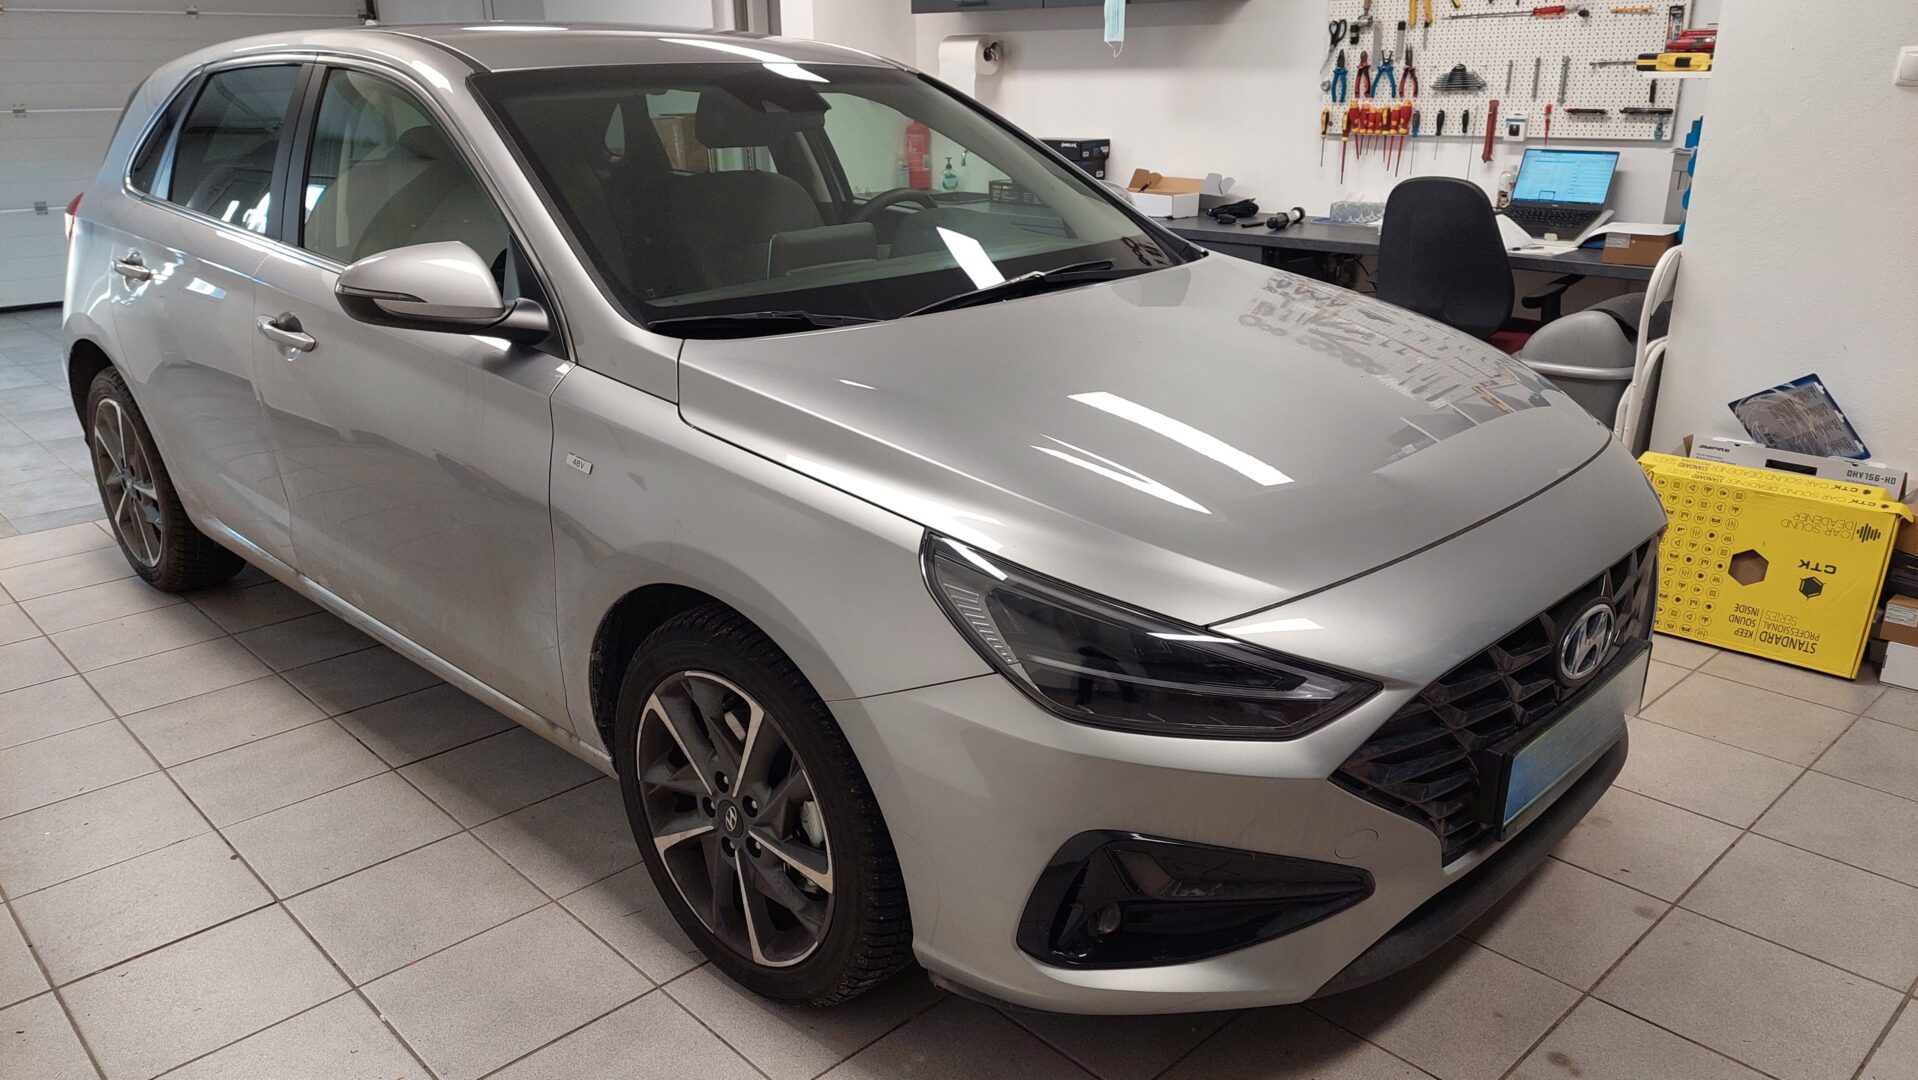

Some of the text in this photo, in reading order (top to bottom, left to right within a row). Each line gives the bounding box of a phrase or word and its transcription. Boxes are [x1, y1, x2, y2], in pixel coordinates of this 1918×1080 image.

[572, 458, 585, 469] 48V
[1678, 462, 1710, 472] STANDARD
[1711, 464, 1764, 479] DEADENER
[1692, 474, 1723, 483] STANDARD
[1726, 477, 1779, 492] DEADENER
[1766, 473, 1802, 485] SOUND
[1805, 480, 1830, 489] CAR
[1782, 487, 1820, 499] SOUND
[1831, 484, 1859, 493] CTK
[1821, 494, 1847, 503] CAR
[1848, 499, 1876, 507] CTK
[1793, 511, 1854, 531] DEADENER
[1780, 518, 1851, 540] CAR SOUND
[1798, 559, 1837, 575] CTK
[1734, 603, 1760, 617] INSIDE
[1728, 614, 1757, 628] SOUND
[1765, 610, 1799, 626] SERIES
[1734, 627, 1754, 639] KEEP
[1762, 620, 1821, 642] PROFESSIONAL
[1759, 630, 1818, 655] STANDARD
